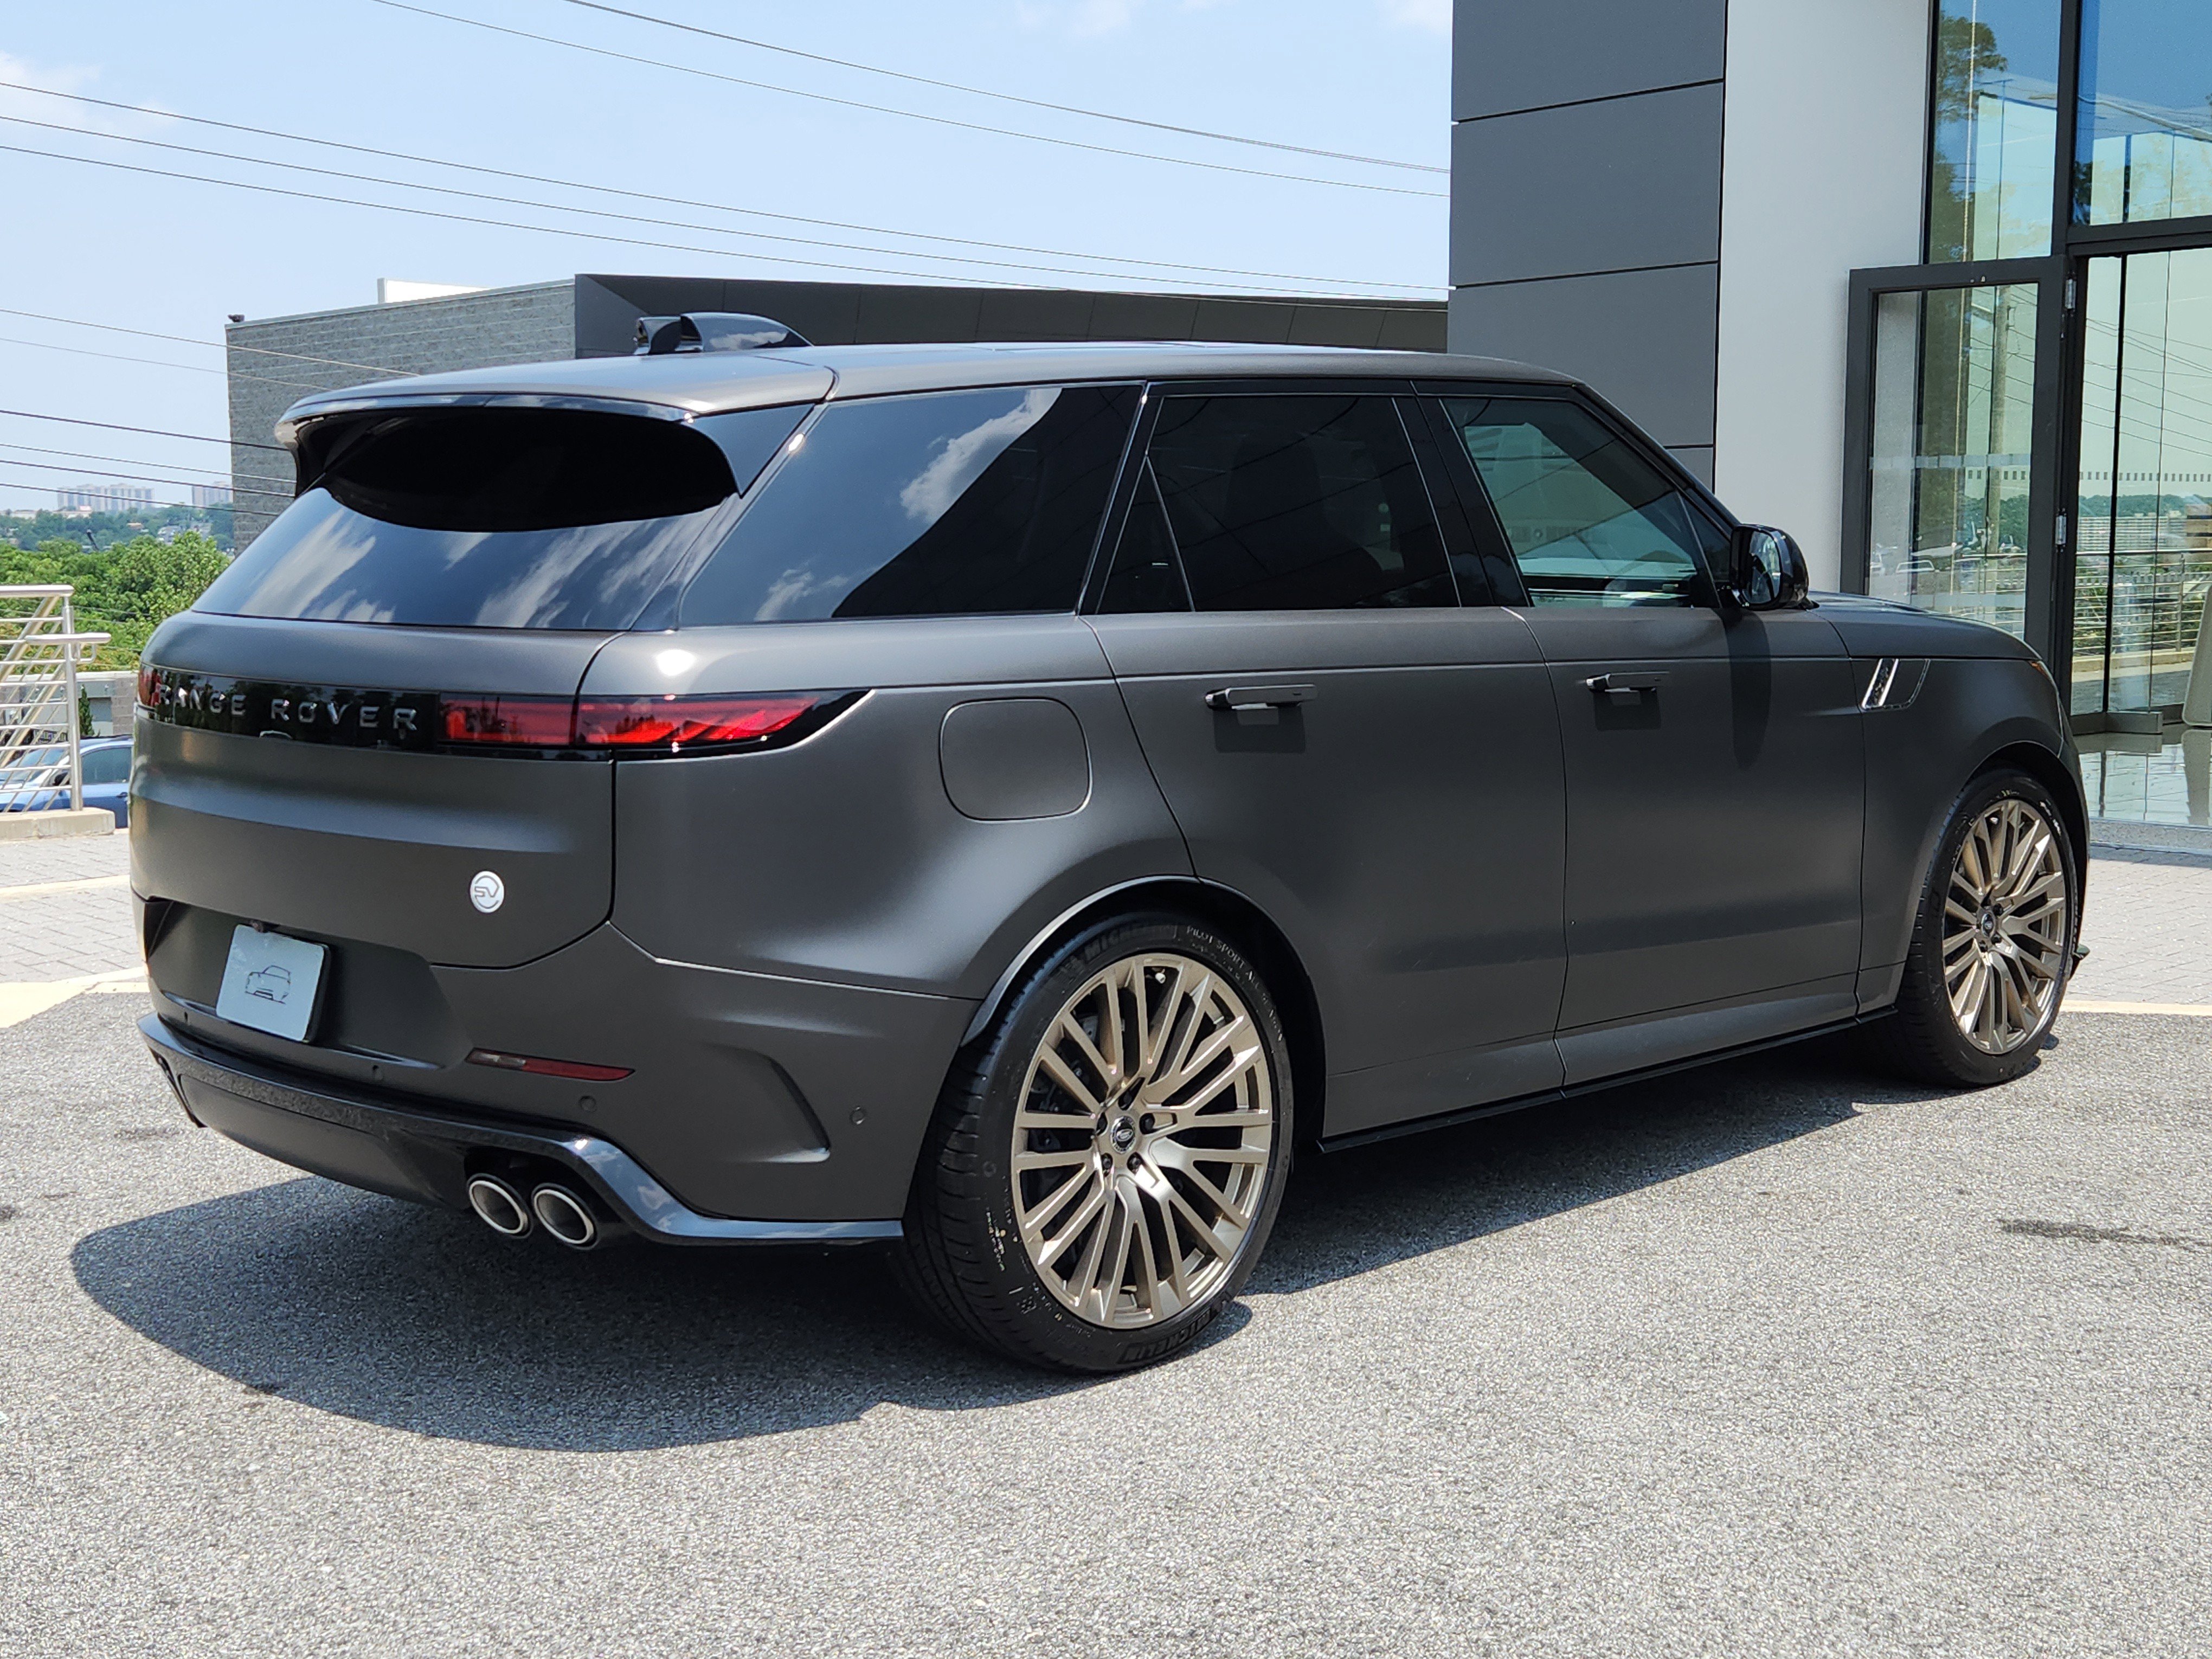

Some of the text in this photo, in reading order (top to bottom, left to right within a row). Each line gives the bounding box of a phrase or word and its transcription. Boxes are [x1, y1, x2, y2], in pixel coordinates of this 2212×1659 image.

[155, 684, 417, 730] RANGE ROVER
[1186, 925, 1213, 943] PILOT
[1217, 940, 1246, 969] SPORT
